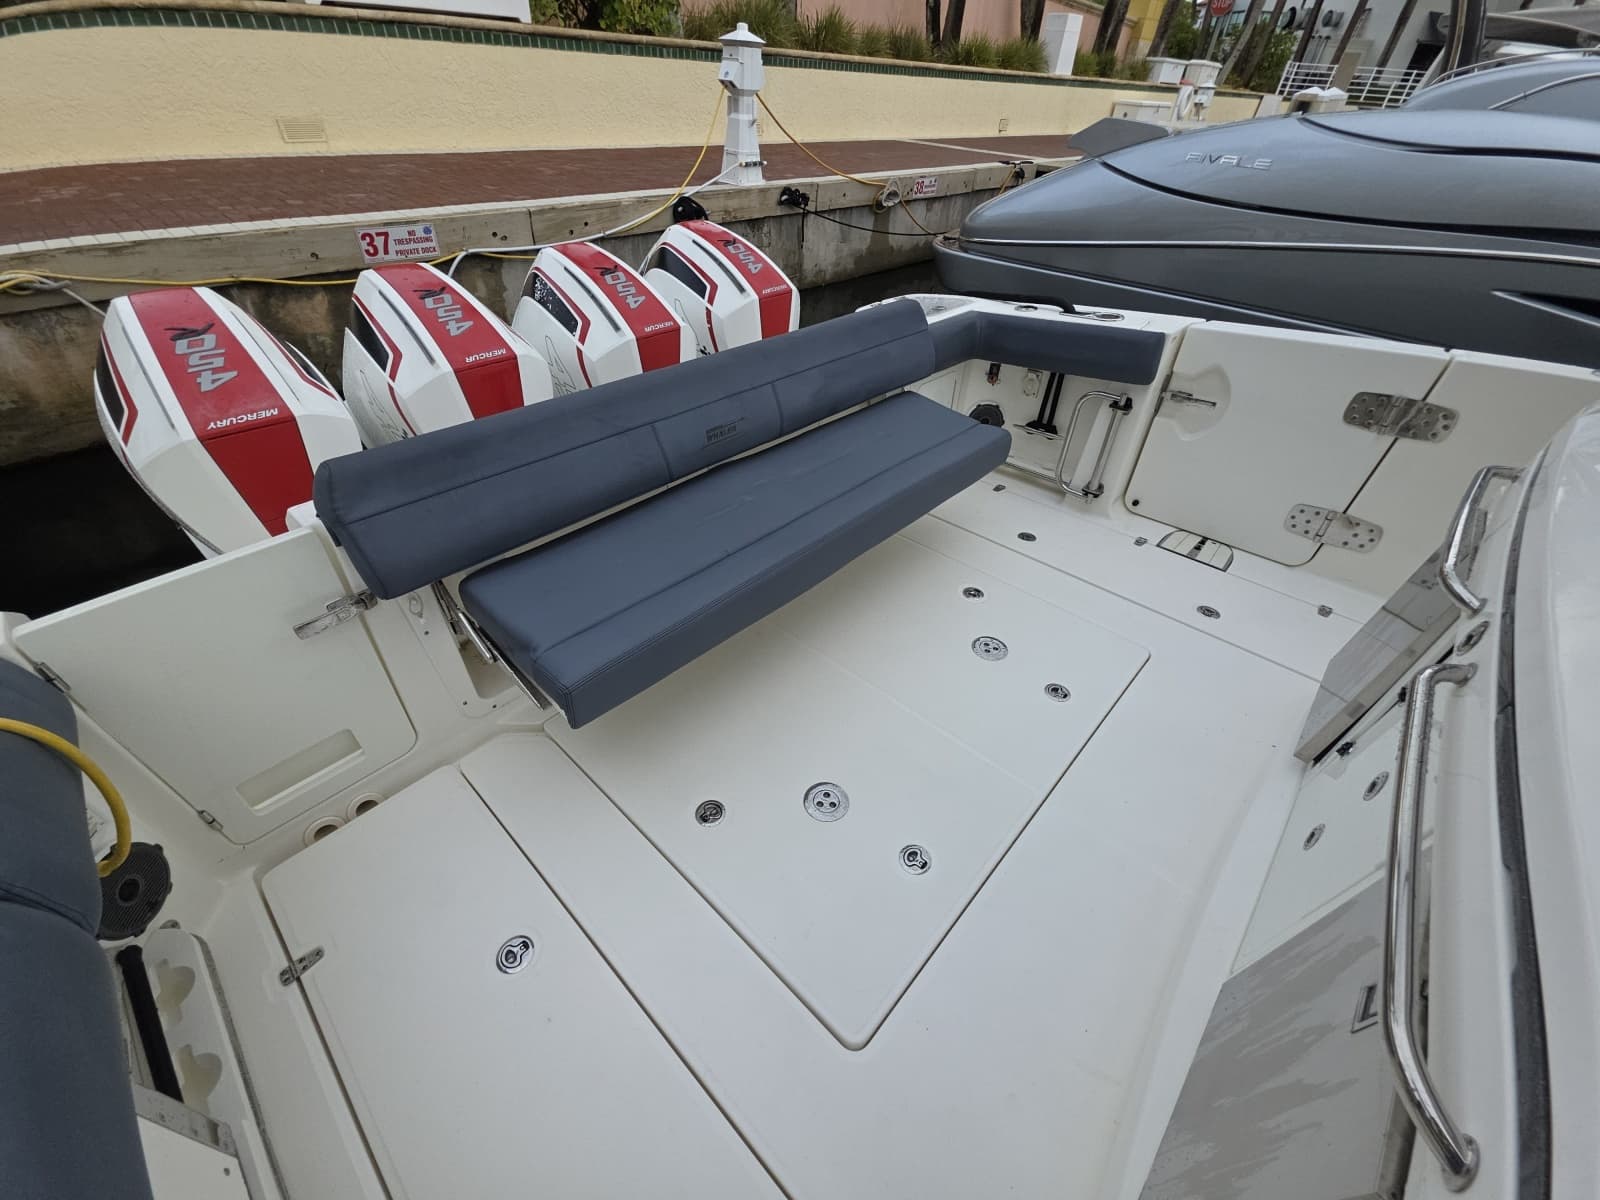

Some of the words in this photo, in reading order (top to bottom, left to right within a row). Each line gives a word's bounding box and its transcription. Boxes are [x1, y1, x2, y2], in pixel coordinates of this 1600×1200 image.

[914, 181, 925, 195] 38
[360, 232, 390, 257] 37
[393, 236, 433, 246] TRESPASSING
[395, 247, 420, 257] PRIVATE
[421, 246, 437, 255] DOCK
[207, 407, 279, 431] MERCURY
